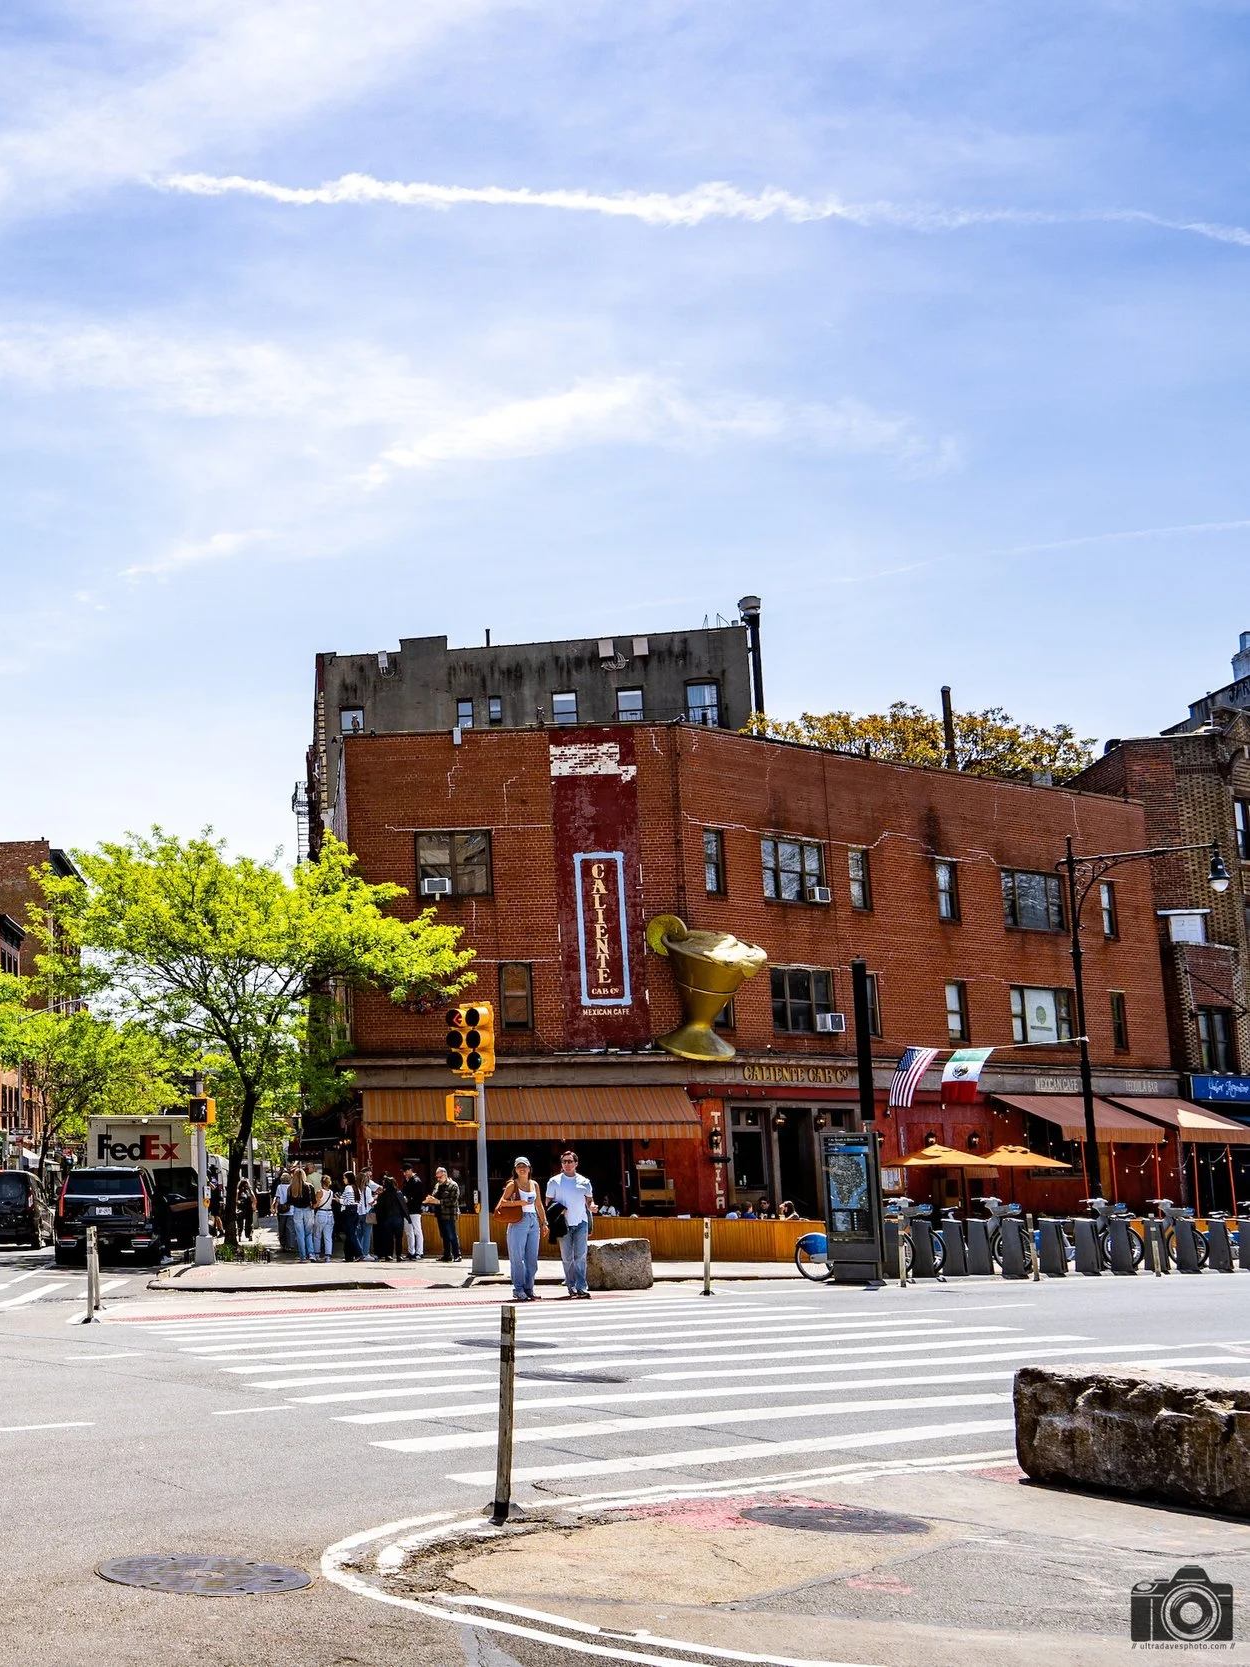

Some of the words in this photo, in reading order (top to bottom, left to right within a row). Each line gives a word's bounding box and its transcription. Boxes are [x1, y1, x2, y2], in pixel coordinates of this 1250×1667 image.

[591, 863, 612, 984] CALIENTE
[582, 1008, 613, 1016] MEXICAN
[614, 1008, 631, 1016] CAFE
[743, 1065, 807, 1083] CALIENTE
[808, 1067, 834, 1084] CAB
[1034, 1077, 1062, 1090] MEXICAN
[1062, 1078, 1079, 1091] CAFE
[1124, 1080, 1147, 1092] TEQUILA
[97, 1133, 180, 1161] FedEx
